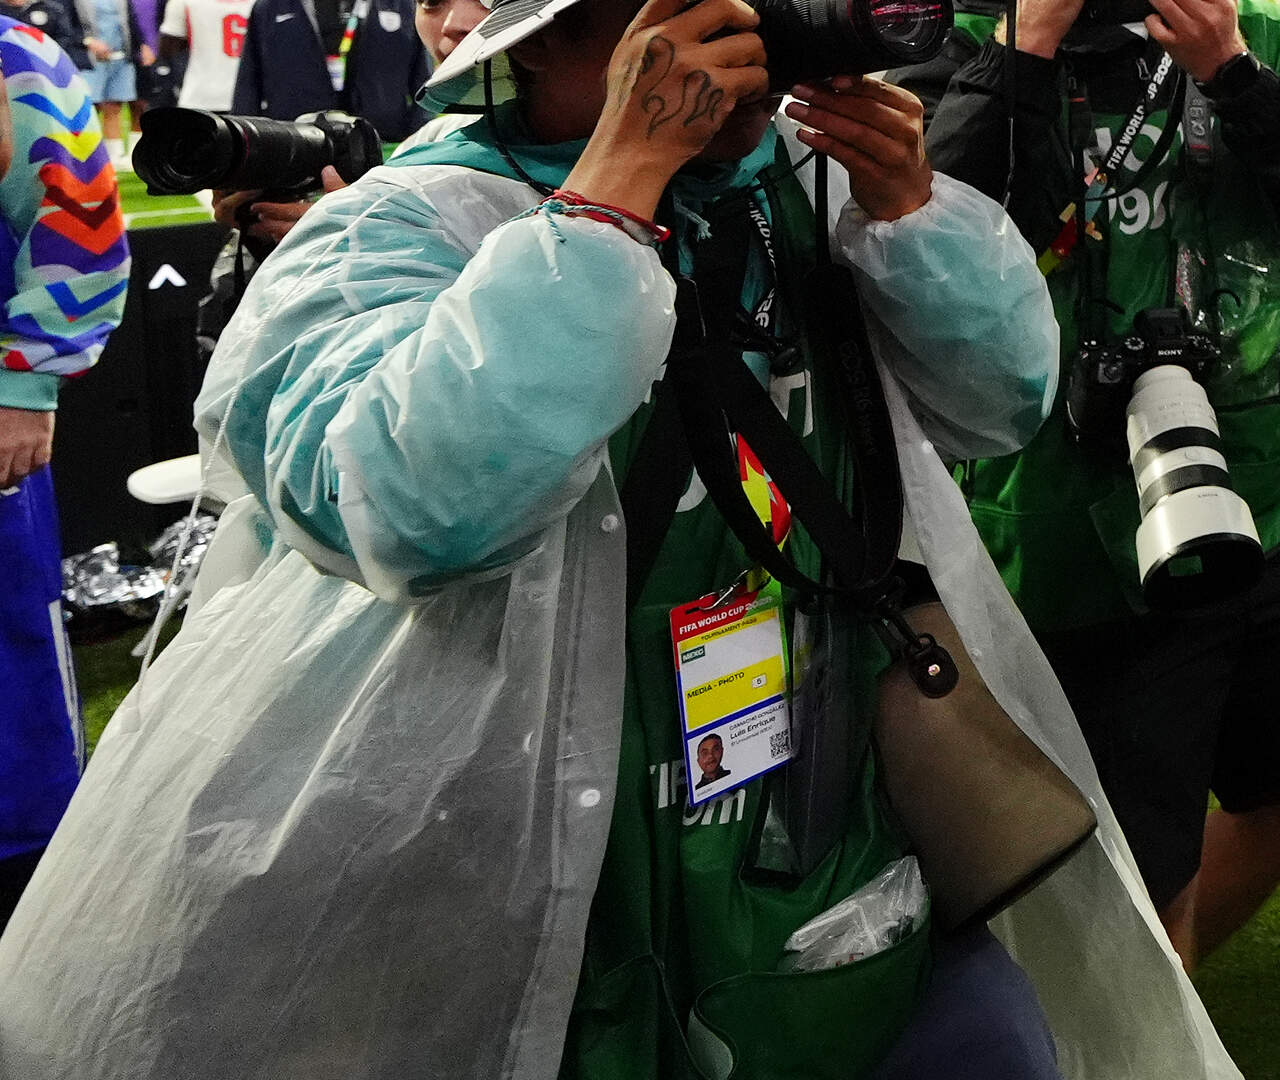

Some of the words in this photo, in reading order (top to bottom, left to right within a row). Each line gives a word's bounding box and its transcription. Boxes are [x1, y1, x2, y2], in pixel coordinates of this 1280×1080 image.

[222, 13, 249, 58] 6
[1106, 144, 1128, 170] FIFA
[679, 623, 698, 635] FIFA
[697, 611, 728, 628] WORLD
[728, 605, 745, 617] CUP
[701, 623, 741, 641] TOURNAMENT
[687, 684, 713, 699] MEDIA
[718, 671, 745, 687] PHOTO
[730, 728, 747, 740] Luis
[747, 715, 776, 733] Enrique
